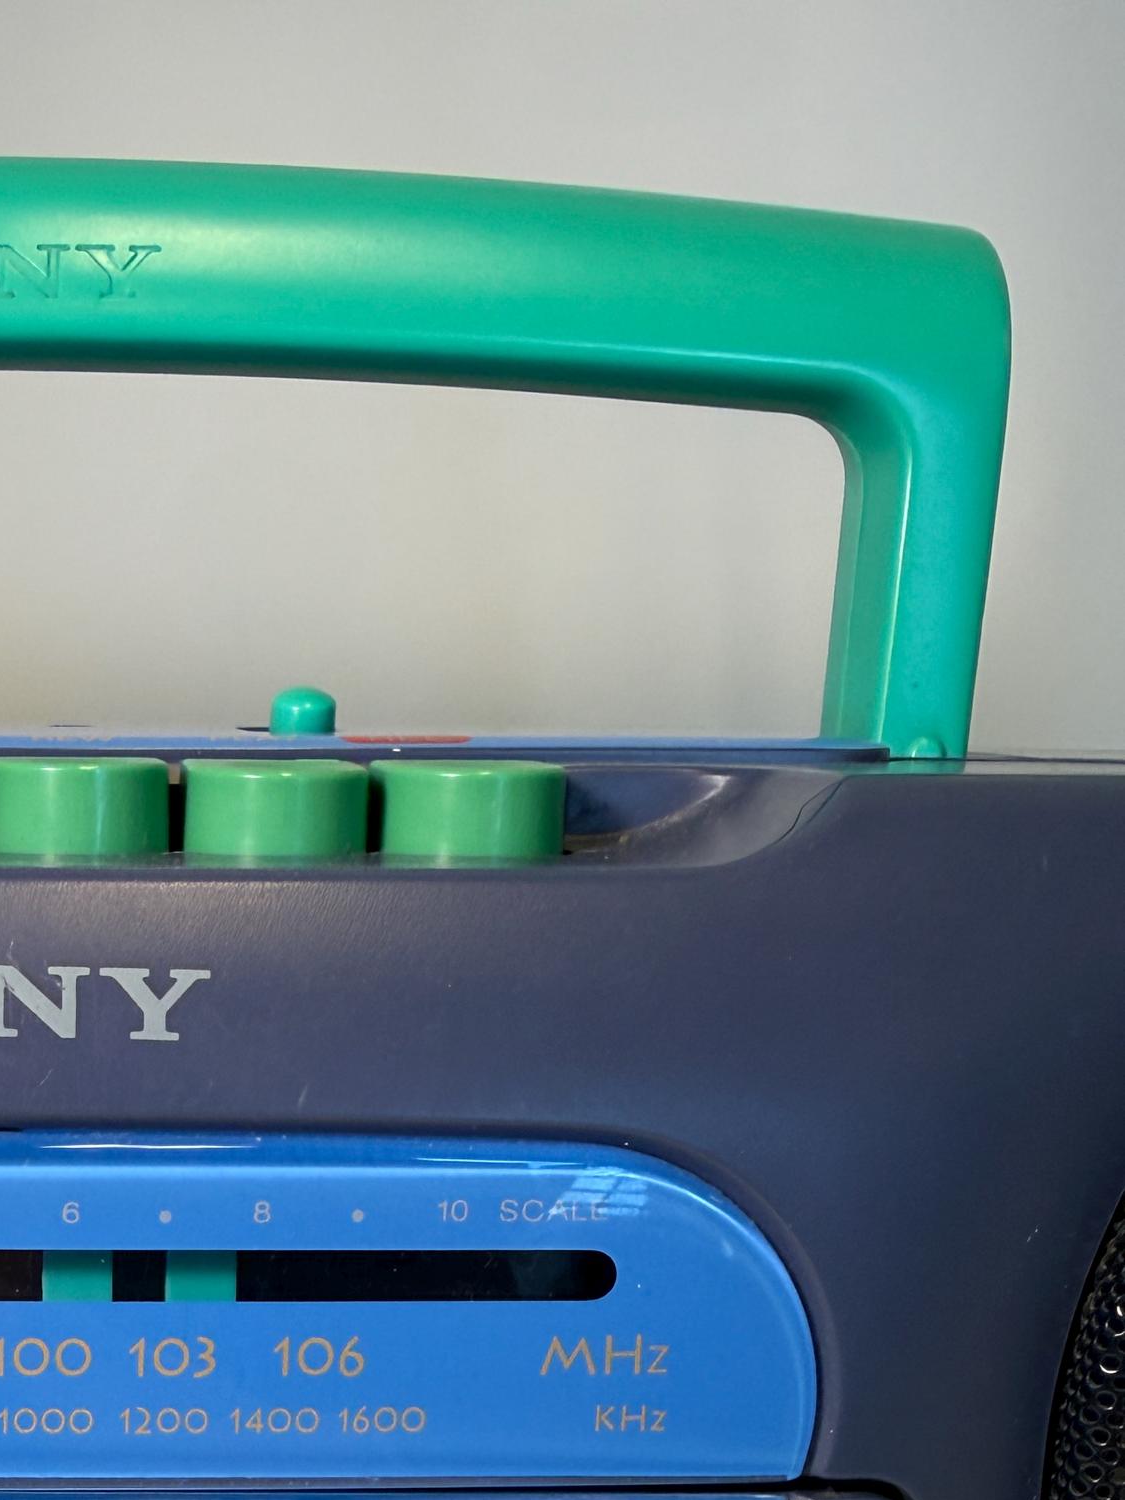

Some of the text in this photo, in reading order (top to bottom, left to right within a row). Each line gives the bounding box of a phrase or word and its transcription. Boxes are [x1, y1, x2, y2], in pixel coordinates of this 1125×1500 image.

[61, 1200, 81, 1225] 6
[253, 1199, 272, 1224] 8
[437, 1199, 469, 1223] 10
[500, 1198, 609, 1223] SCALE
[128, 1335, 217, 1379] 103
[272, 1335, 366, 1379] 106
[539, 1334, 670, 1377] MHz
[119, 1407, 210, 1436] 1200
[229, 1407, 321, 1435] 1400
[338, 1406, 427, 1435] 1600
[594, 1405, 668, 1433] KHz
